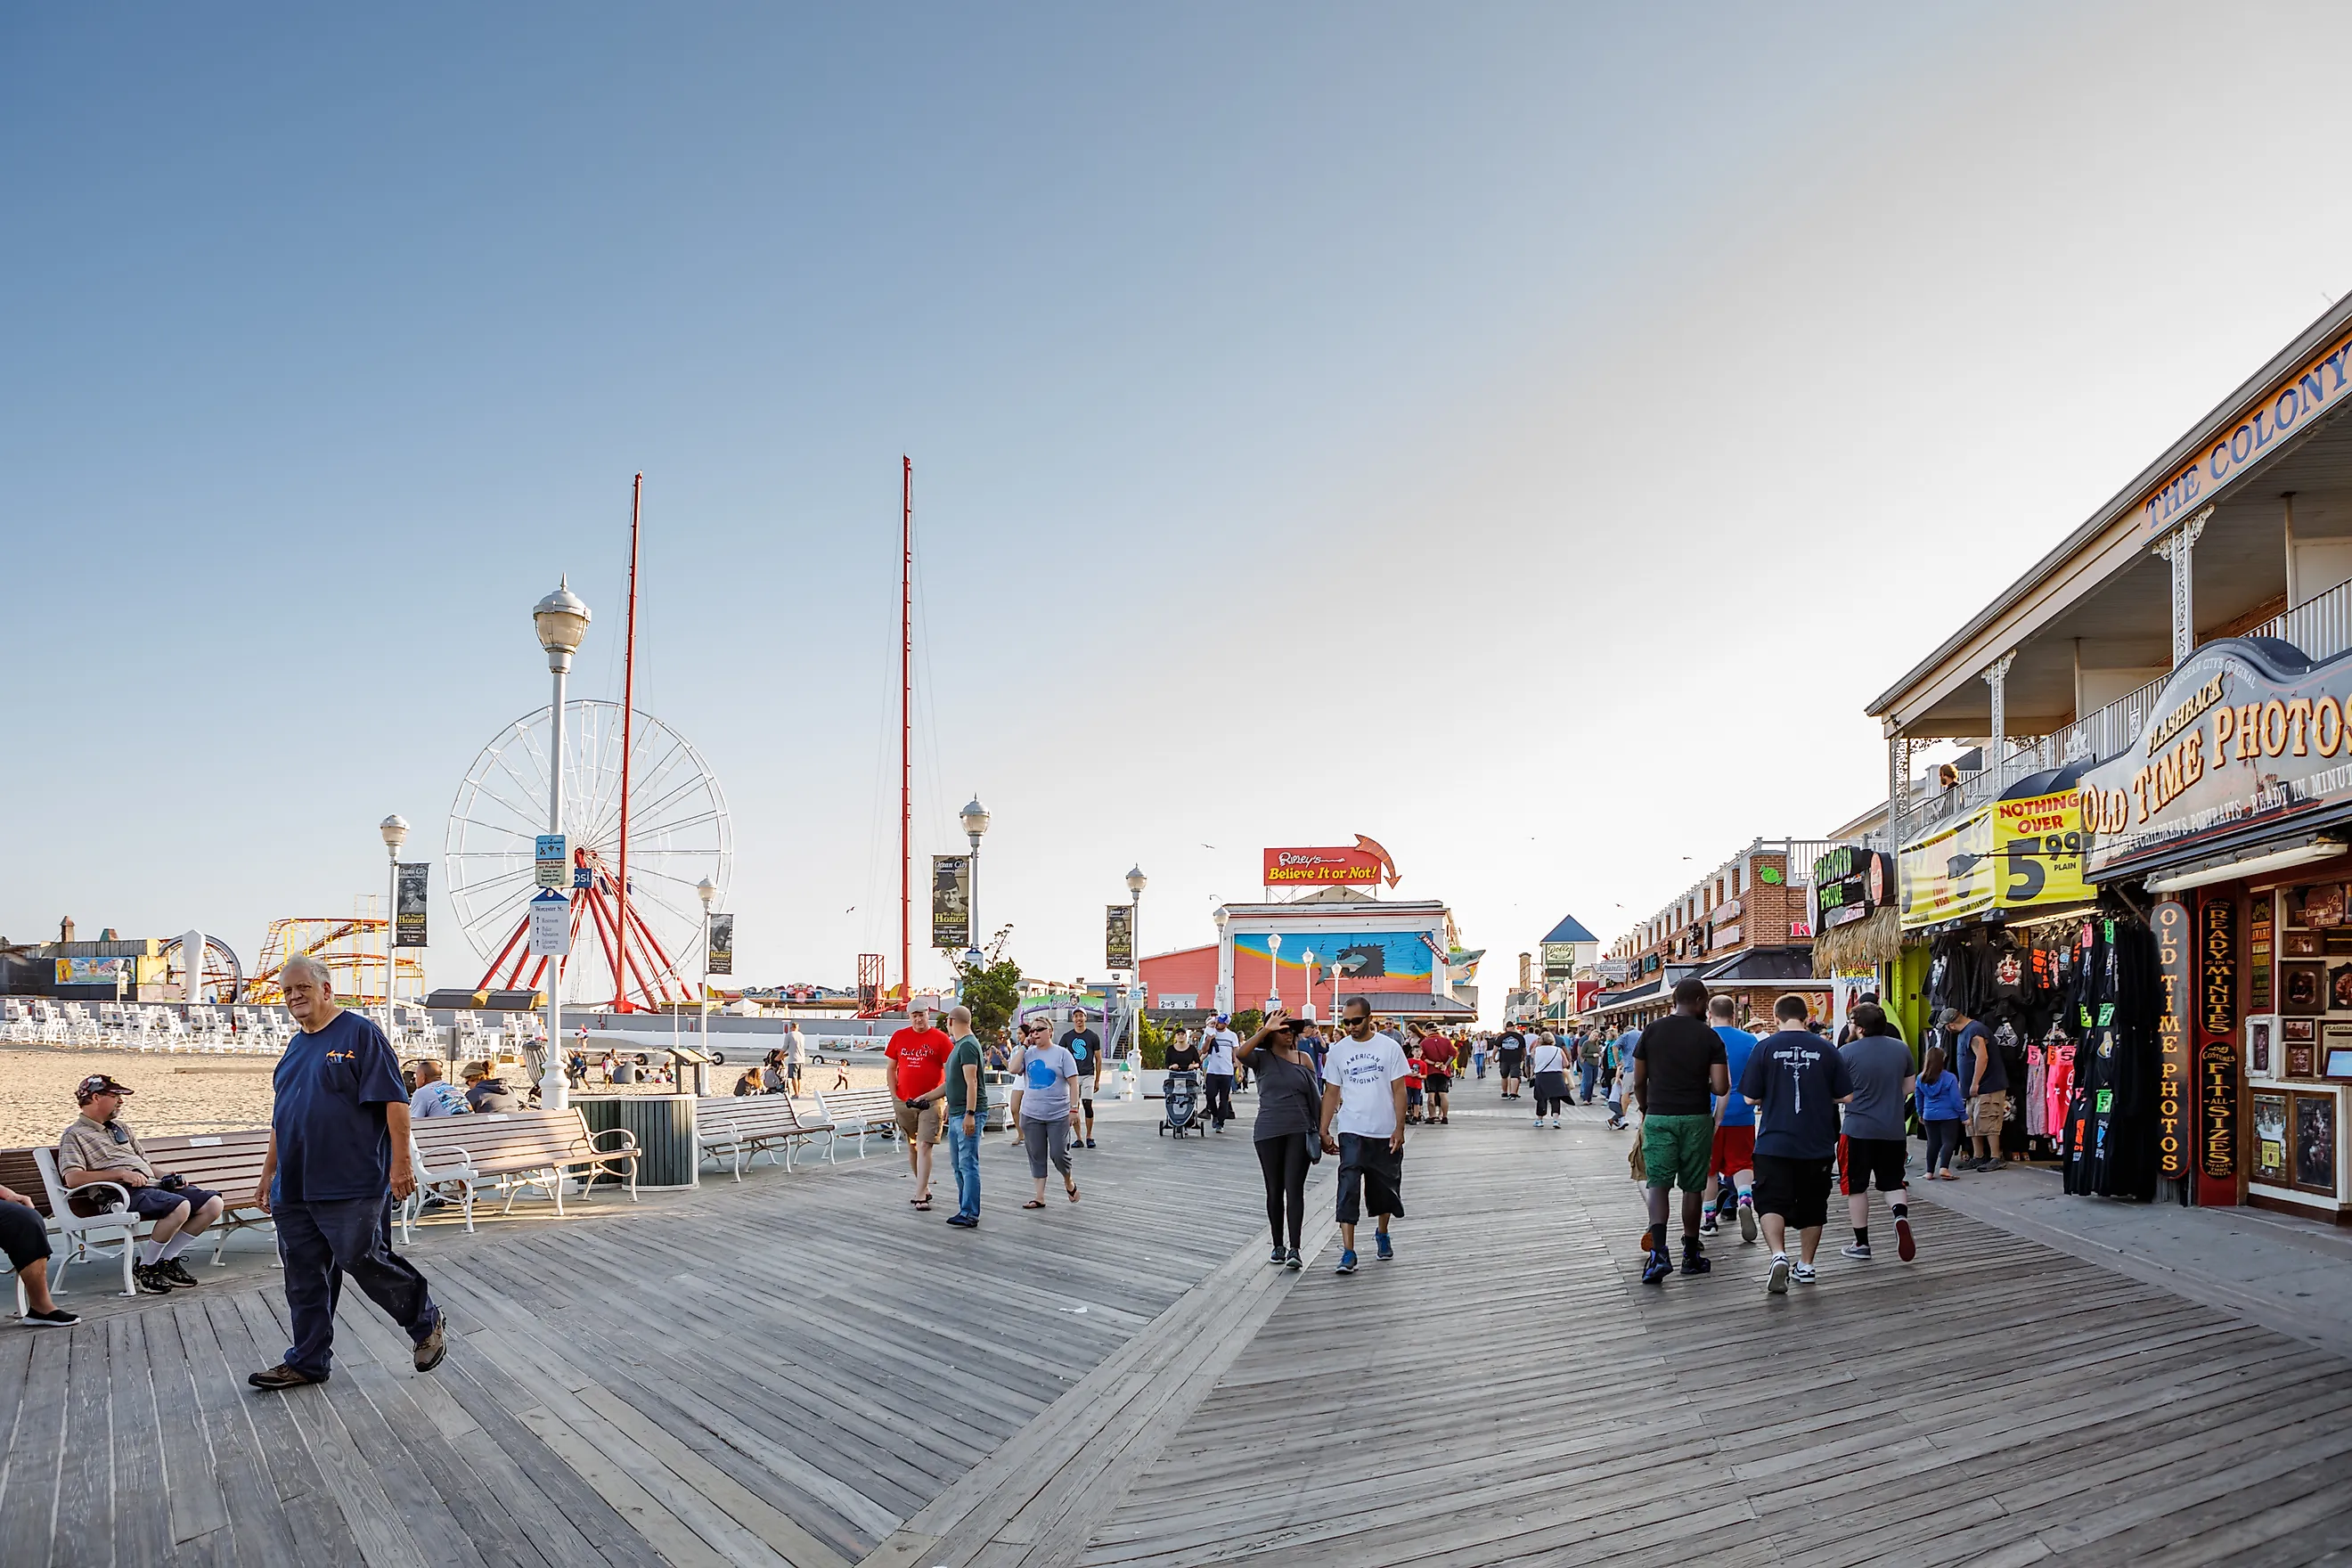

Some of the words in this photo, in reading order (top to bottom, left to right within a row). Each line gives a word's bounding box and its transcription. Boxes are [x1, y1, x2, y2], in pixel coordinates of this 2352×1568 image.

[2145, 464, 2201, 529] THE
[2210, 340, 2352, 480] COLONY
[2225, 659, 2256, 690] ORIGINAL
[2146, 671, 2225, 758] FLASHBACK
[2081, 783, 2129, 835] OLD
[2134, 727, 2204, 824] TIME
[1999, 792, 2079, 819] NOTHING
[2140, 814, 2188, 848] CHILDREN'S
[2191, 799, 2242, 833] PORTRAITS
[2250, 782, 2290, 815] READY
[2291, 778, 2307, 803] IN
[2017, 814, 2064, 834] OVER
[935, 861, 954, 869] Ocean
[954, 860, 968, 870] City
[1268, 867, 1315, 880] Believe
[1317, 866, 1330, 879] It
[1332, 870, 1345, 879] or
[1347, 865, 1378, 879] Not!
[2054, 862, 2077, 871] PLAIN
[398, 914, 425, 924] Honor
[935, 913, 968, 923] Honor
[2160, 908, 2178, 965] OLD
[2208, 910, 2230, 960] READY
[1108, 944, 1131, 952] Honor
[2206, 966, 2233, 1033] MINUTES
[2158, 974, 2182, 1053] TIME
[1345, 1053, 1381, 1066] AMERICAN
[2030, 1050, 2038, 1060] 5
[2050, 1050, 2055, 1060] 5
[2061, 1051, 2073, 1061] 5
[2202, 1051, 2236, 1062] COSTUMES
[1349, 1074, 1379, 1084] ORIGINAL
[2206, 1063, 2231, 1097] FIT
[2101, 1096, 2109, 1107] 5
[2160, 1062, 2179, 1172] PHOTOS
[2208, 1106, 2231, 1164] SIZES
